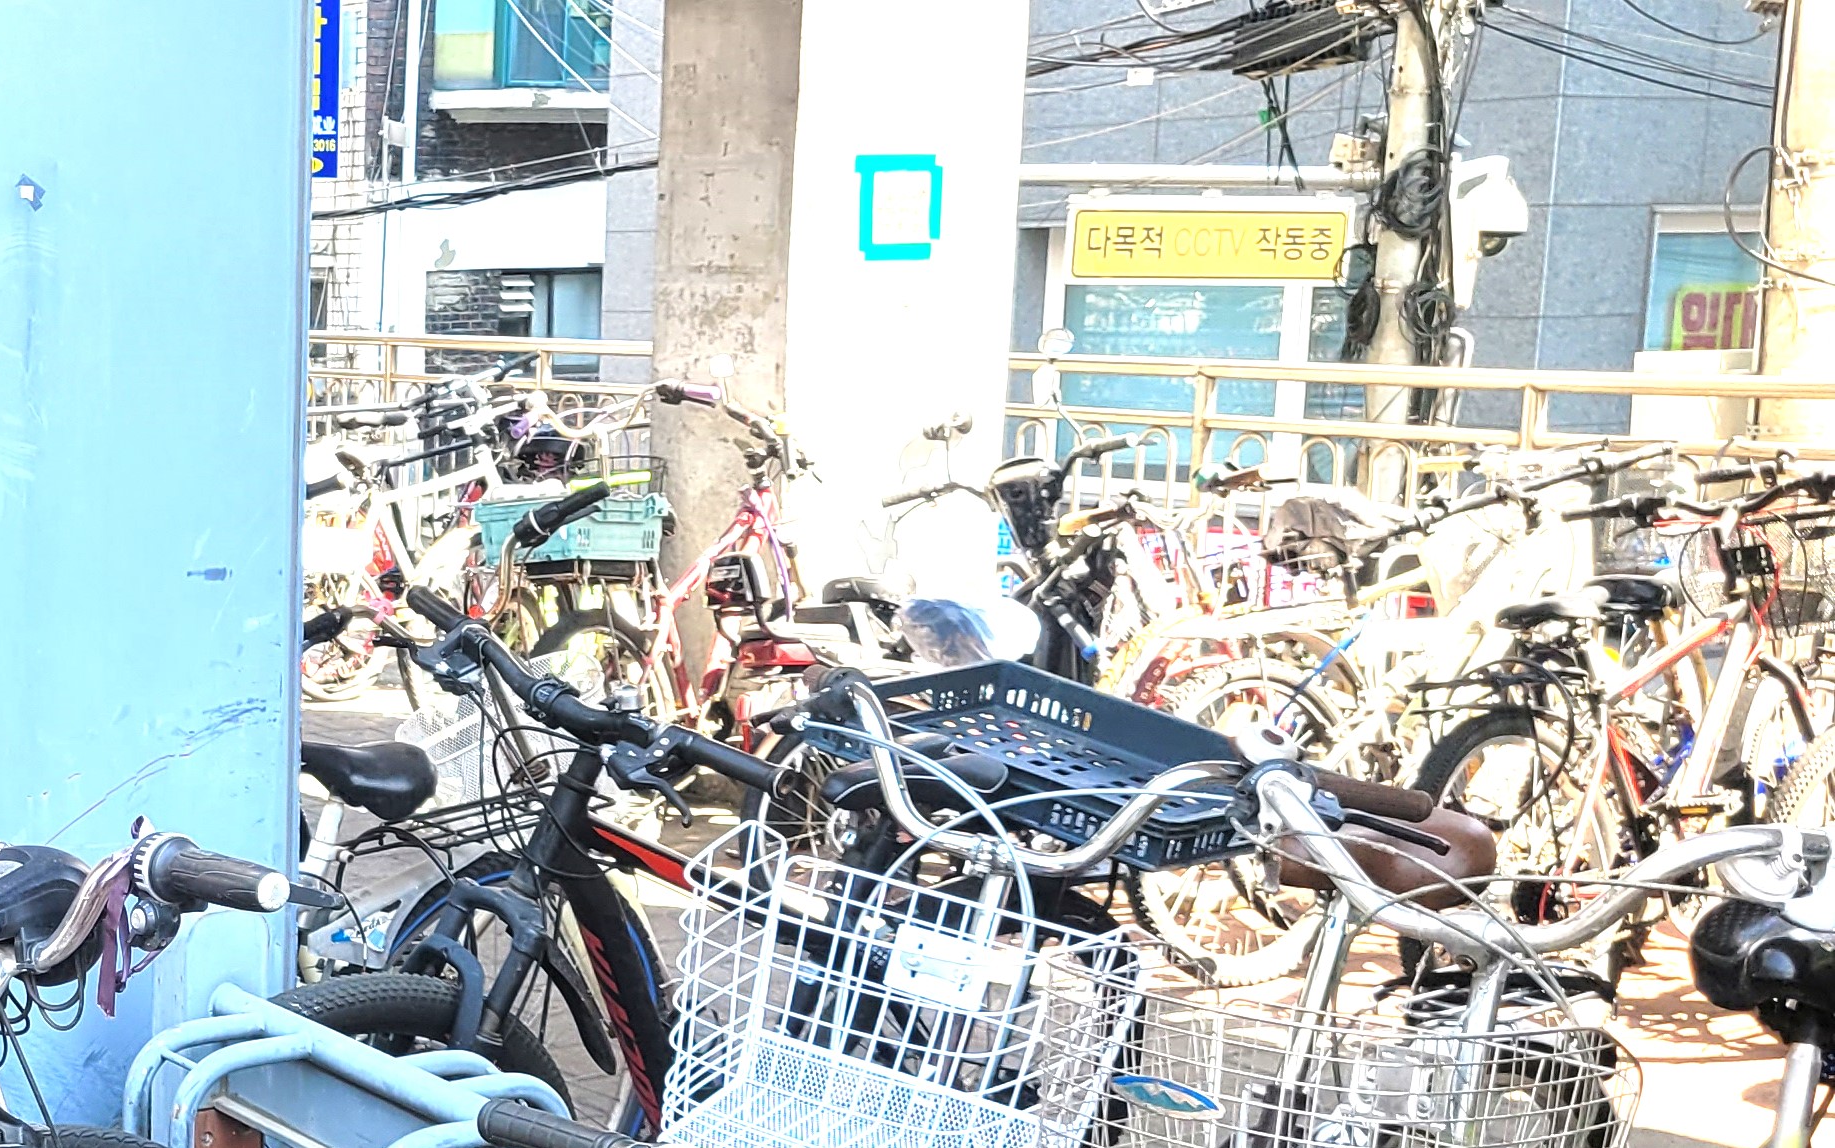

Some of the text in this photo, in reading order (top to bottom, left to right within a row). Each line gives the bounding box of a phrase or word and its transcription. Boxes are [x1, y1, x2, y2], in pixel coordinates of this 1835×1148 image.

[1087, 225, 1334, 261] 다목적 CCTV 작동중
